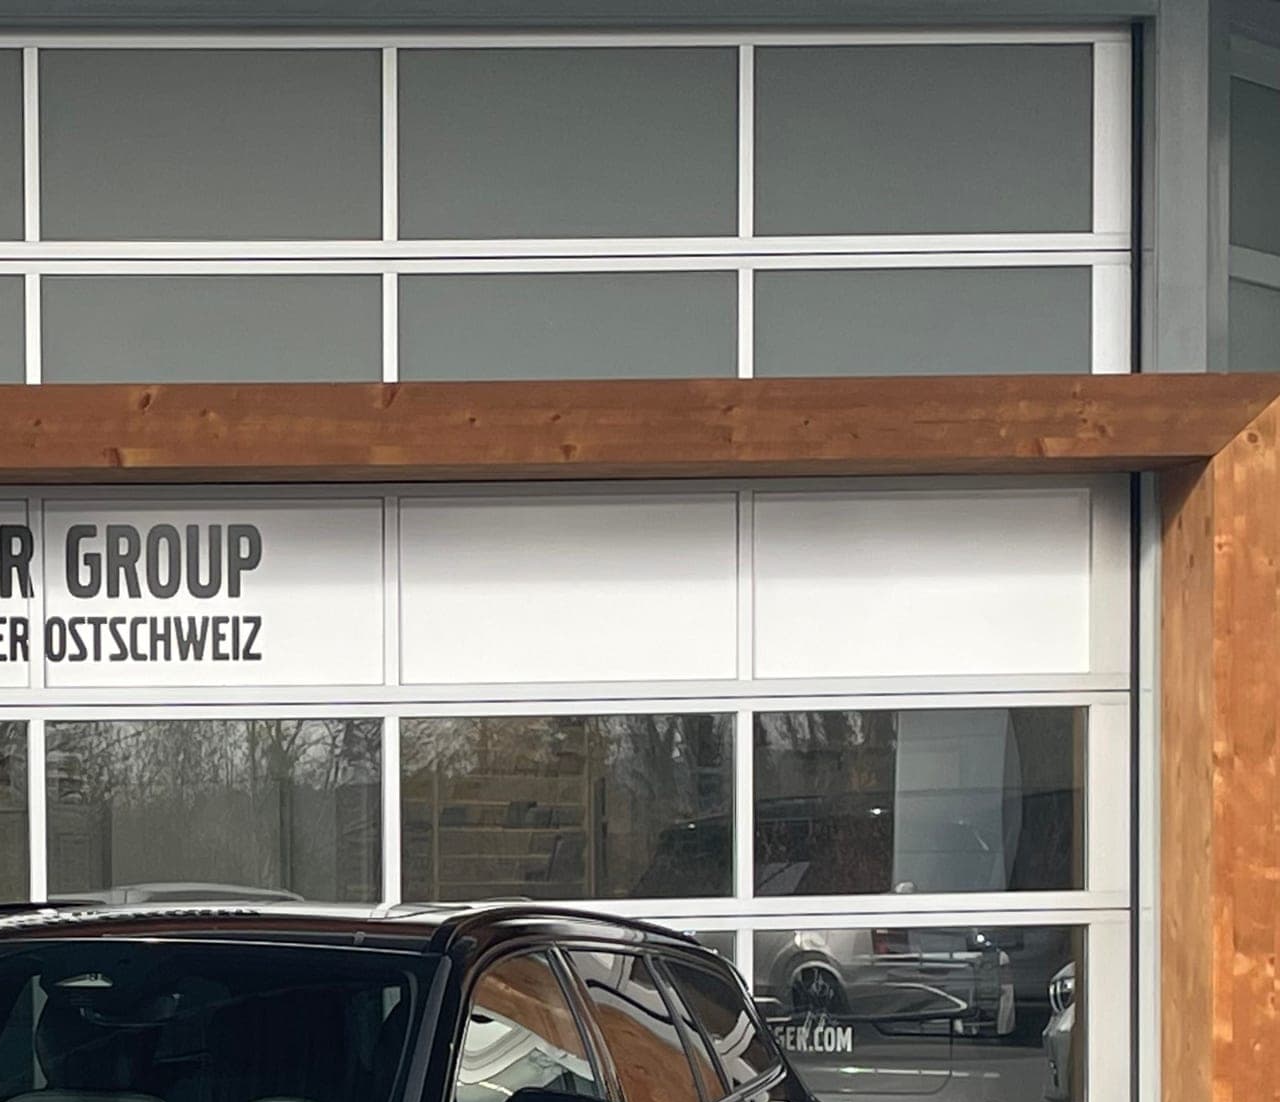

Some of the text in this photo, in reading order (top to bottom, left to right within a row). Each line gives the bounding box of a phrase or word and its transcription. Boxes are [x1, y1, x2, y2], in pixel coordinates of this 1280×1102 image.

[65, 523, 262, 599] GROUP
[45, 615, 262, 662] OSTSCHWEIZ
[768, 1026, 853, 1053] GER.COM
